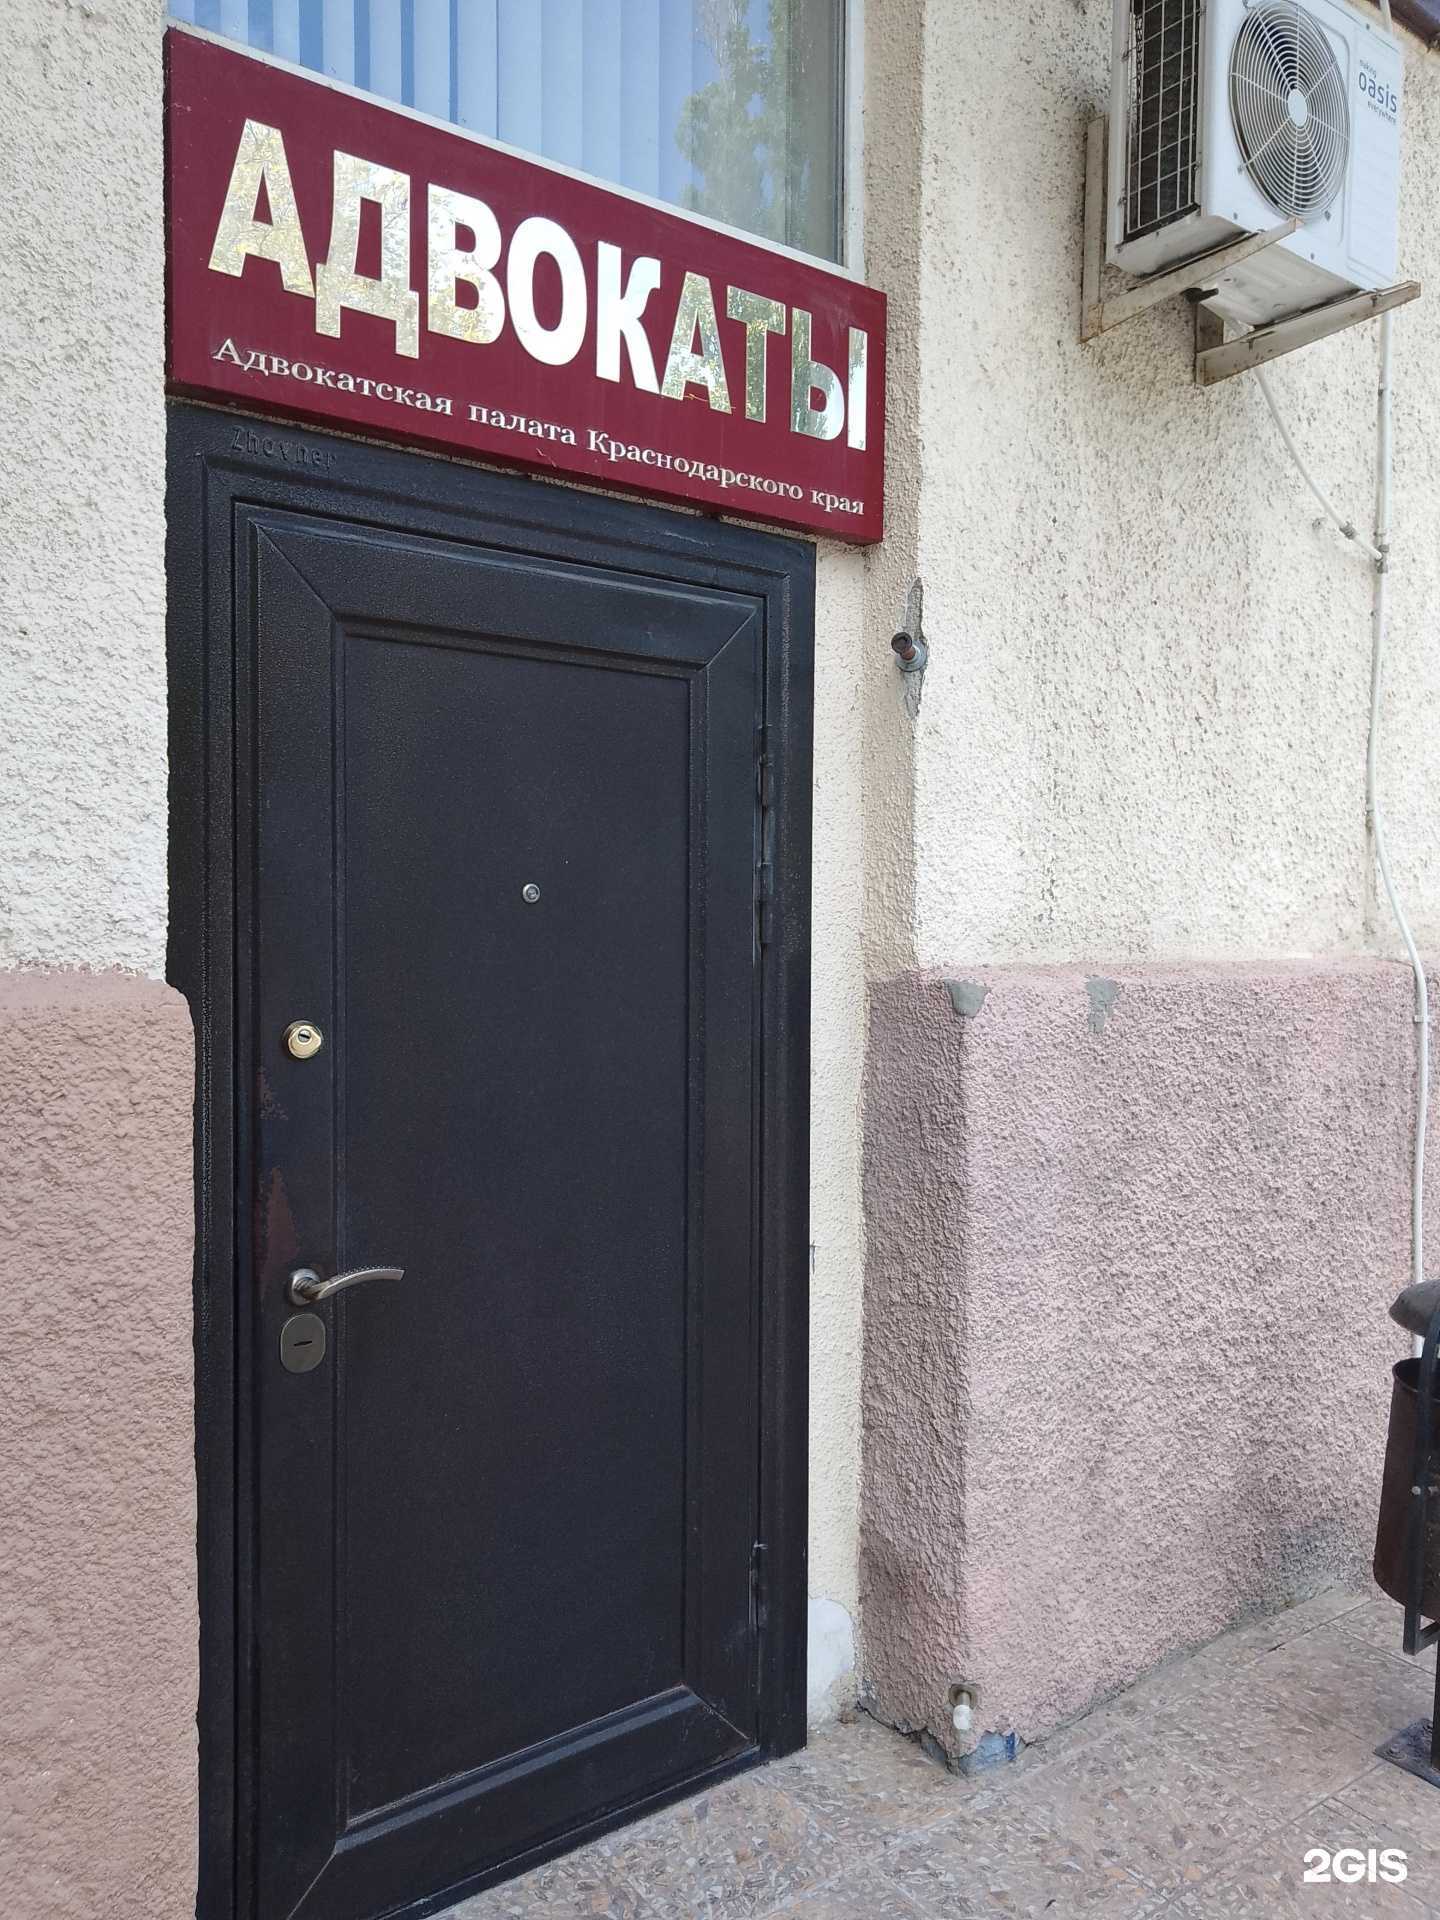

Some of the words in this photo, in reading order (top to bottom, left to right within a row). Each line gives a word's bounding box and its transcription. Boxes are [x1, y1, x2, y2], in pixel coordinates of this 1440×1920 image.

[1359, 72, 1397, 113] oasis
[208, 118, 867, 451] АДВОКАТЫ
[212, 338, 453, 415] Адвокатская
[468, 403, 577, 446] палата
[585, 428, 803, 500] Краснодарского
[811, 488, 865, 515] края
